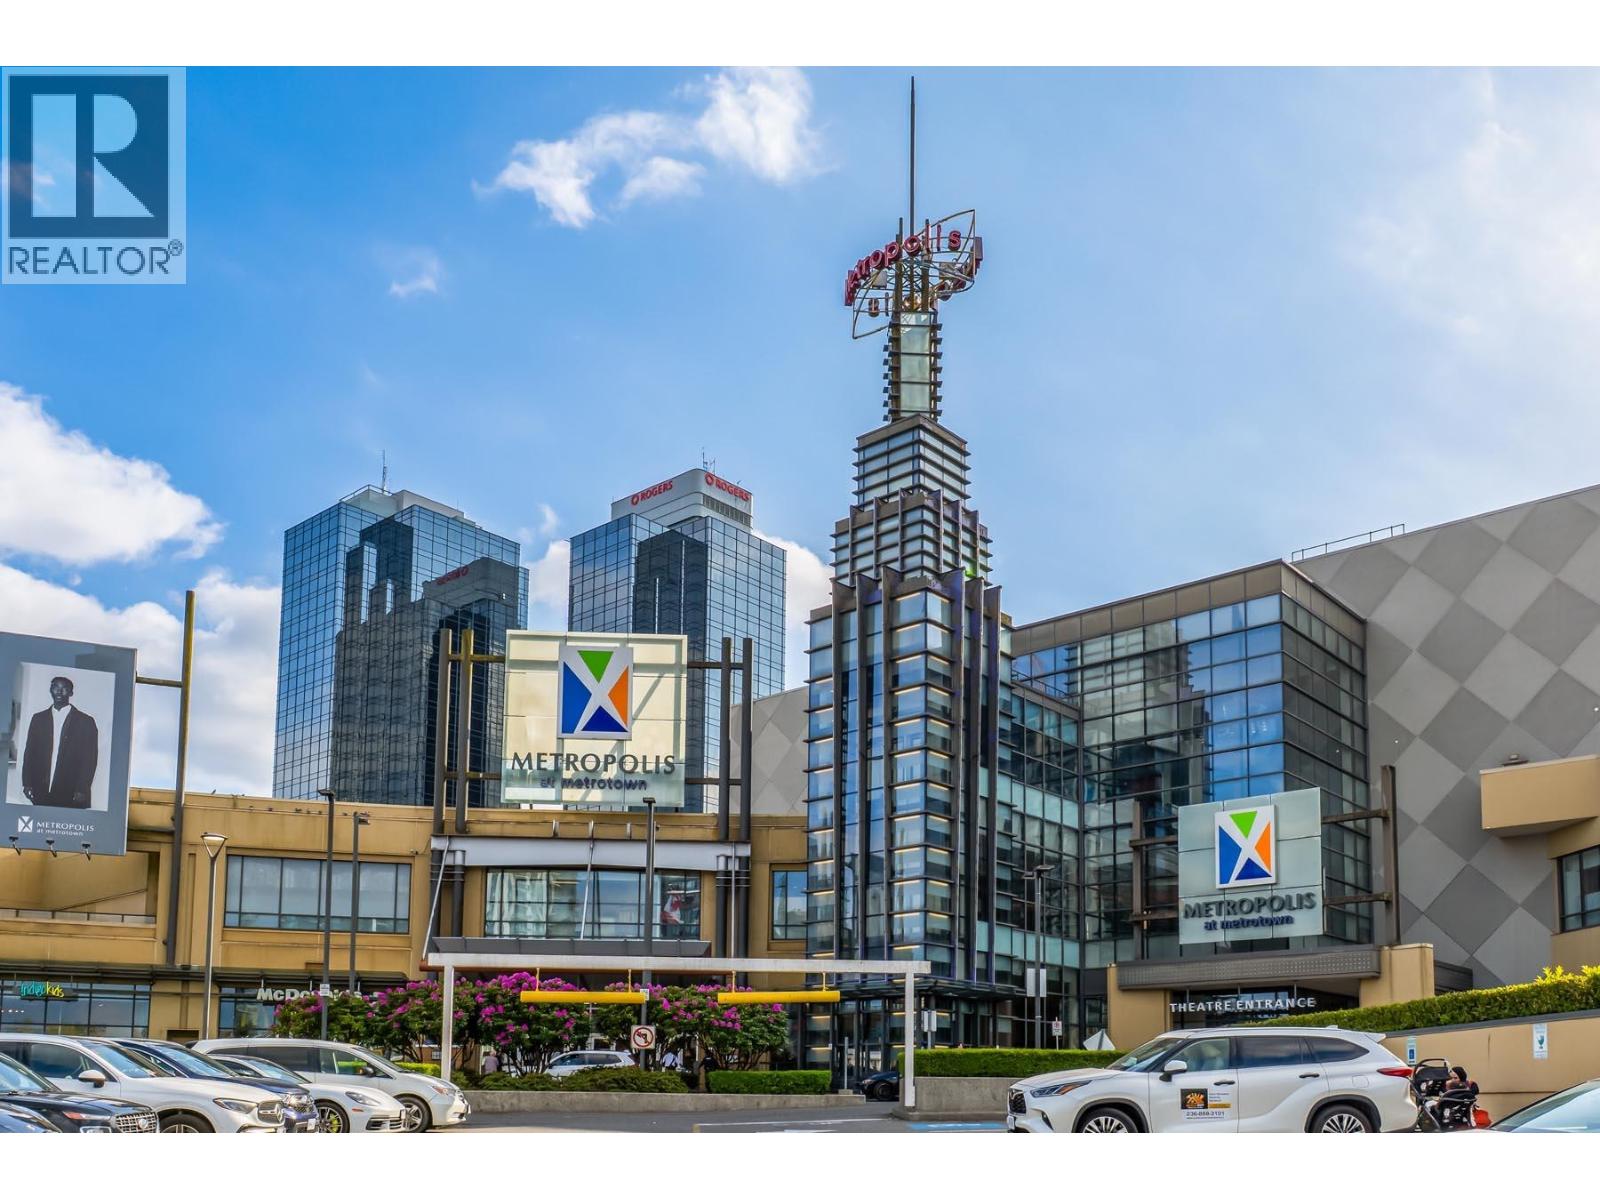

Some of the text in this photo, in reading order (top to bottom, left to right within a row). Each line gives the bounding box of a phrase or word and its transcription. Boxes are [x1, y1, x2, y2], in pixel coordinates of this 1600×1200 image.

[640, 481, 673, 501] ROGERS
[715, 478, 750, 501] ROGERS
[511, 752, 676, 775] METROPOLIS
[540, 777, 648, 791] at metrotown
[36, 821, 95, 832] METROPOLIS
[45, 829, 84, 837] metrotown
[1183, 892, 1317, 919] METROPOLIS
[1203, 915, 1294, 931] at metrotown
[1169, 997, 1317, 1013] THEATRE ENTRANCE
